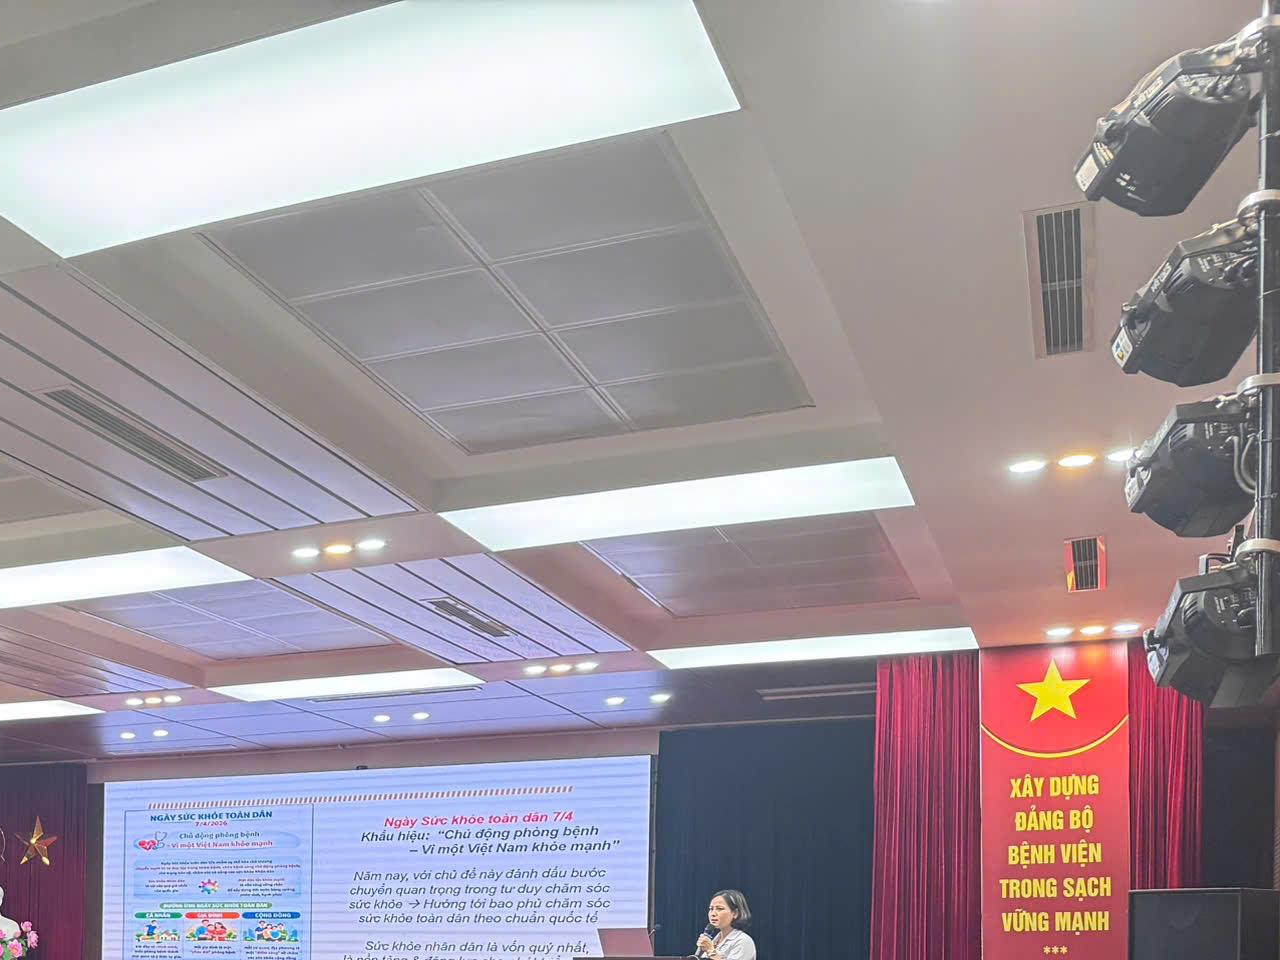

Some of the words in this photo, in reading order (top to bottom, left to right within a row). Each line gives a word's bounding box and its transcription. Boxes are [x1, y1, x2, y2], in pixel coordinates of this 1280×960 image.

[1009, 773, 1045, 798] XÂY
[1049, 774, 1100, 800] DỰNG
[384, 817, 417, 829] Ngày
[421, 816, 448, 826] Sức
[488, 813, 518, 824] toàn
[522, 812, 549, 823] dân
[553, 811, 574, 822] 7/4
[1015, 804, 1064, 832] ĐẢNG
[1069, 805, 1094, 833] BỘ
[361, 830, 394, 842] Khẩu
[397, 831, 430, 843] hiệu:
[475, 828, 510, 841] động
[513, 827, 559, 840] phòng
[563, 826, 599, 839] bệnh
[437, 844, 464, 856] một
[468, 842, 493, 856] Việt
[496, 843, 528, 853] Nam
[531, 841, 567, 852] khỏe
[1008, 841, 1056, 869] BỆNH
[1060, 839, 1102, 867] VIỆN
[353, 871, 382, 881] Năm
[384, 872, 409, 883] nay,
[413, 870, 431, 880] với
[434, 869, 457, 880] chủ
[479, 869, 503, 881] này
[505, 868, 538, 879] đánh
[542, 866, 567, 878] dấu
[570, 867, 606, 878] bước
[349, 883, 392, 897] chuyển
[395, 887, 426, 897] quan
[429, 885, 461, 897] trọng
[464, 884, 497, 896] trong
[500, 884, 515, 894] tư
[517, 883, 542, 896] duy
[545, 883, 582, 894] chăm
[586, 883, 610, 893] sóc
[999, 878, 1057, 899] TRONG
[1062, 877, 1112, 902] SẠCH
[349, 899, 371, 909] sức
[373, 899, 403, 909] khỏe
[423, 899, 466, 911] Hướng
[470, 898, 486, 909] tới
[489, 899, 513, 909] bao
[516, 898, 542, 911] phủ
[545, 898, 582, 909] chăm
[586, 898, 611, 908] sóc
[359, 913, 381, 923] sức
[383, 913, 413, 923] khỏe
[416, 913, 443, 923] toàn
[446, 913, 470, 923] dân
[474, 913, 501, 923] theo
[505, 911, 545, 923] chuẩn
[549, 911, 582, 925] quốc
[585, 910, 599, 923] tế
[1001, 908, 1050, 932] VỮNG
[1055, 911, 1110, 936] MẠNH
[365, 940, 390, 951] Sức
[392, 941, 422, 951] khỏe
[424, 941, 456, 952] nhân
[459, 941, 483, 952] dân
[487, 942, 498, 952] là
[502, 940, 525, 953] vốn
[529, 942, 554, 955] quý
[556, 940, 589, 954] nhất,
